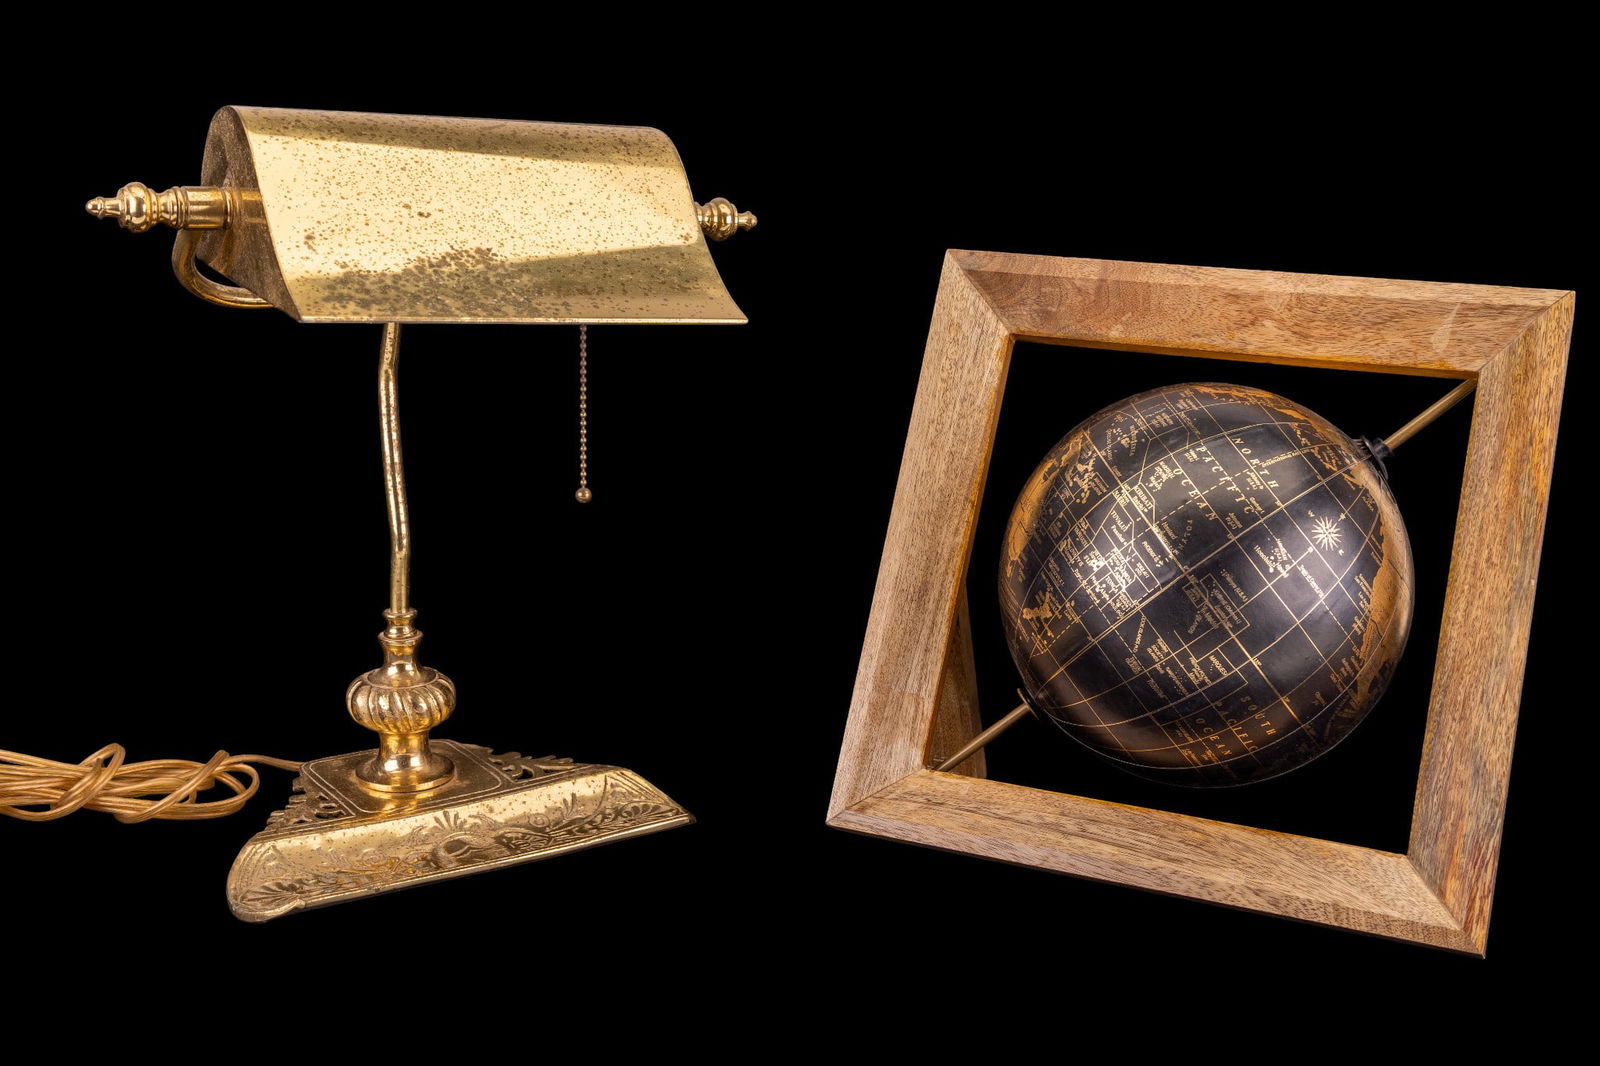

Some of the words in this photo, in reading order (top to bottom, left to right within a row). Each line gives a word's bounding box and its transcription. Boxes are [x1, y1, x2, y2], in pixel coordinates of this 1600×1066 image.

[1195, 444, 1255, 515] PACIFIC
[1231, 434, 1279, 490] NORTH
[1133, 486, 1153, 509] KIRIBATI
[1172, 466, 1217, 522] OCEAN
[1307, 509, 1315, 518] W
[1253, 545, 1275, 567] Honolulu
[1194, 715, 1232, 758] OCEAN
[1213, 699, 1258, 754] PACIFIC
[1239, 693, 1277, 737] SOUTH
